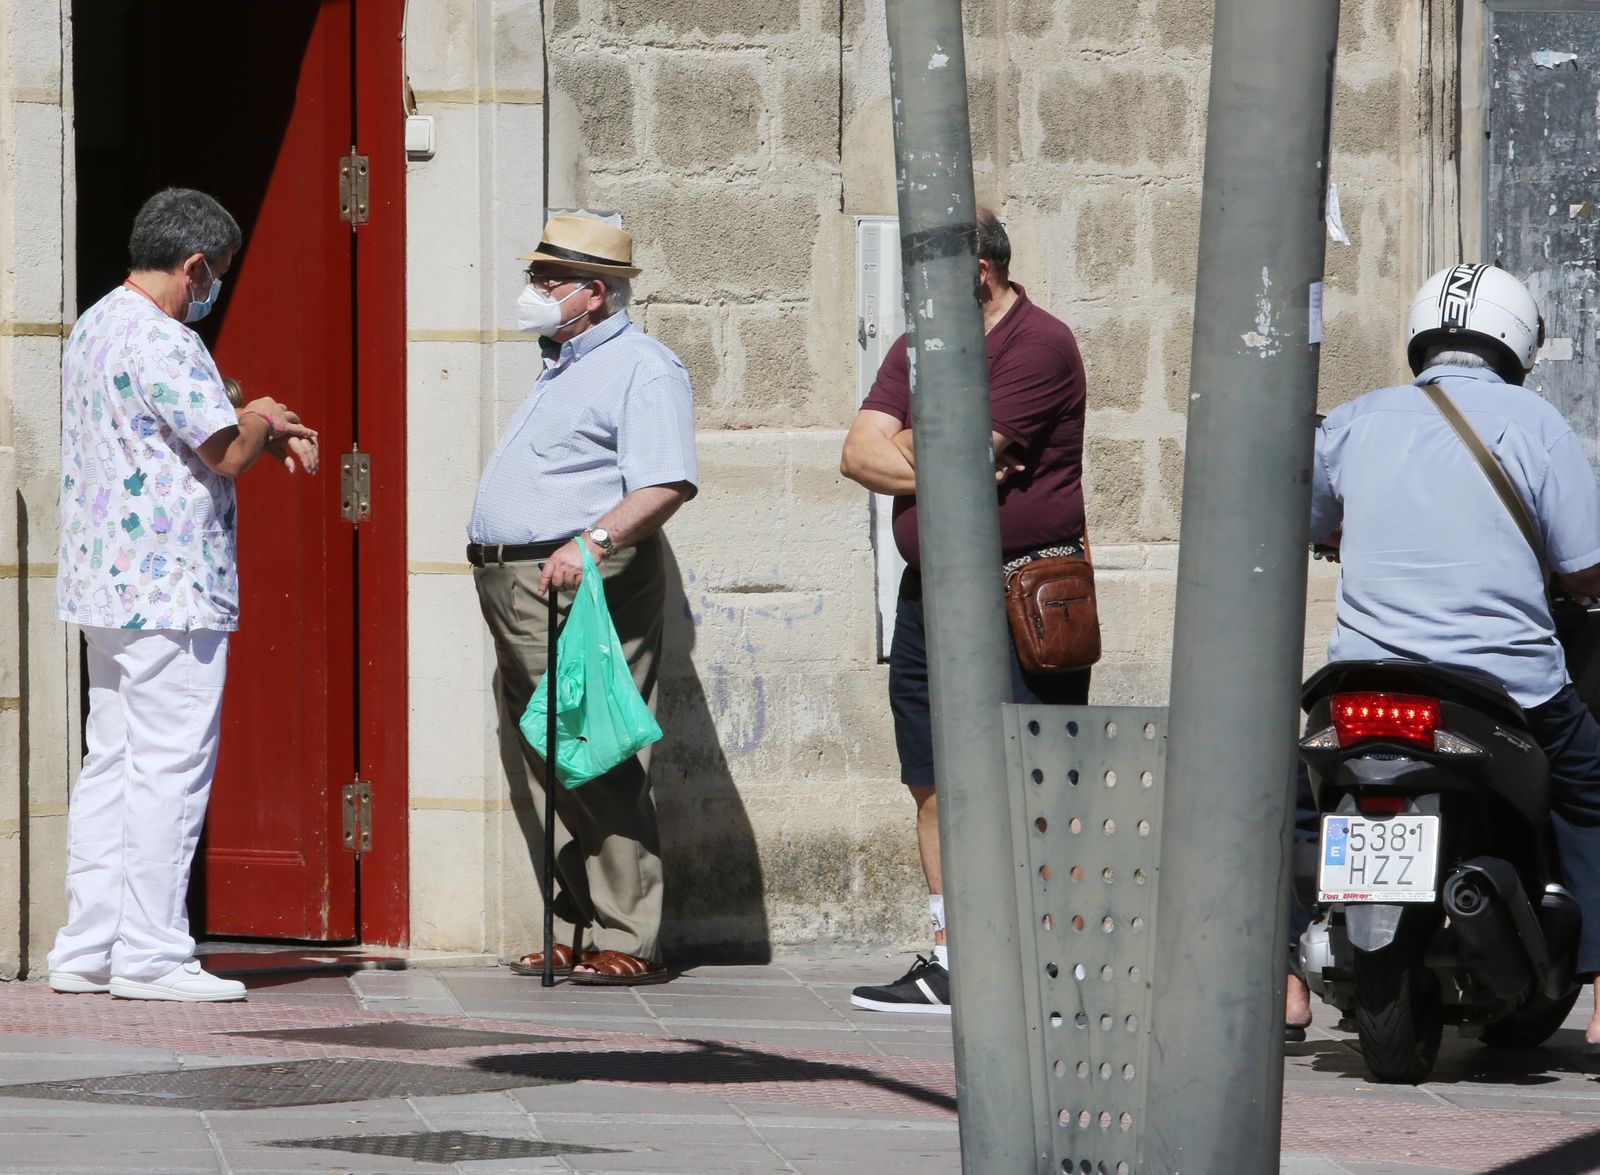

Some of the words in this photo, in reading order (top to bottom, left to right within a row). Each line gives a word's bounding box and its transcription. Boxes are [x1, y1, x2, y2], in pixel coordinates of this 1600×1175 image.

[1330, 846, 1341, 858] E
[1350, 823, 1424, 852] 5381
[1349, 855, 1414, 885] HZZ
